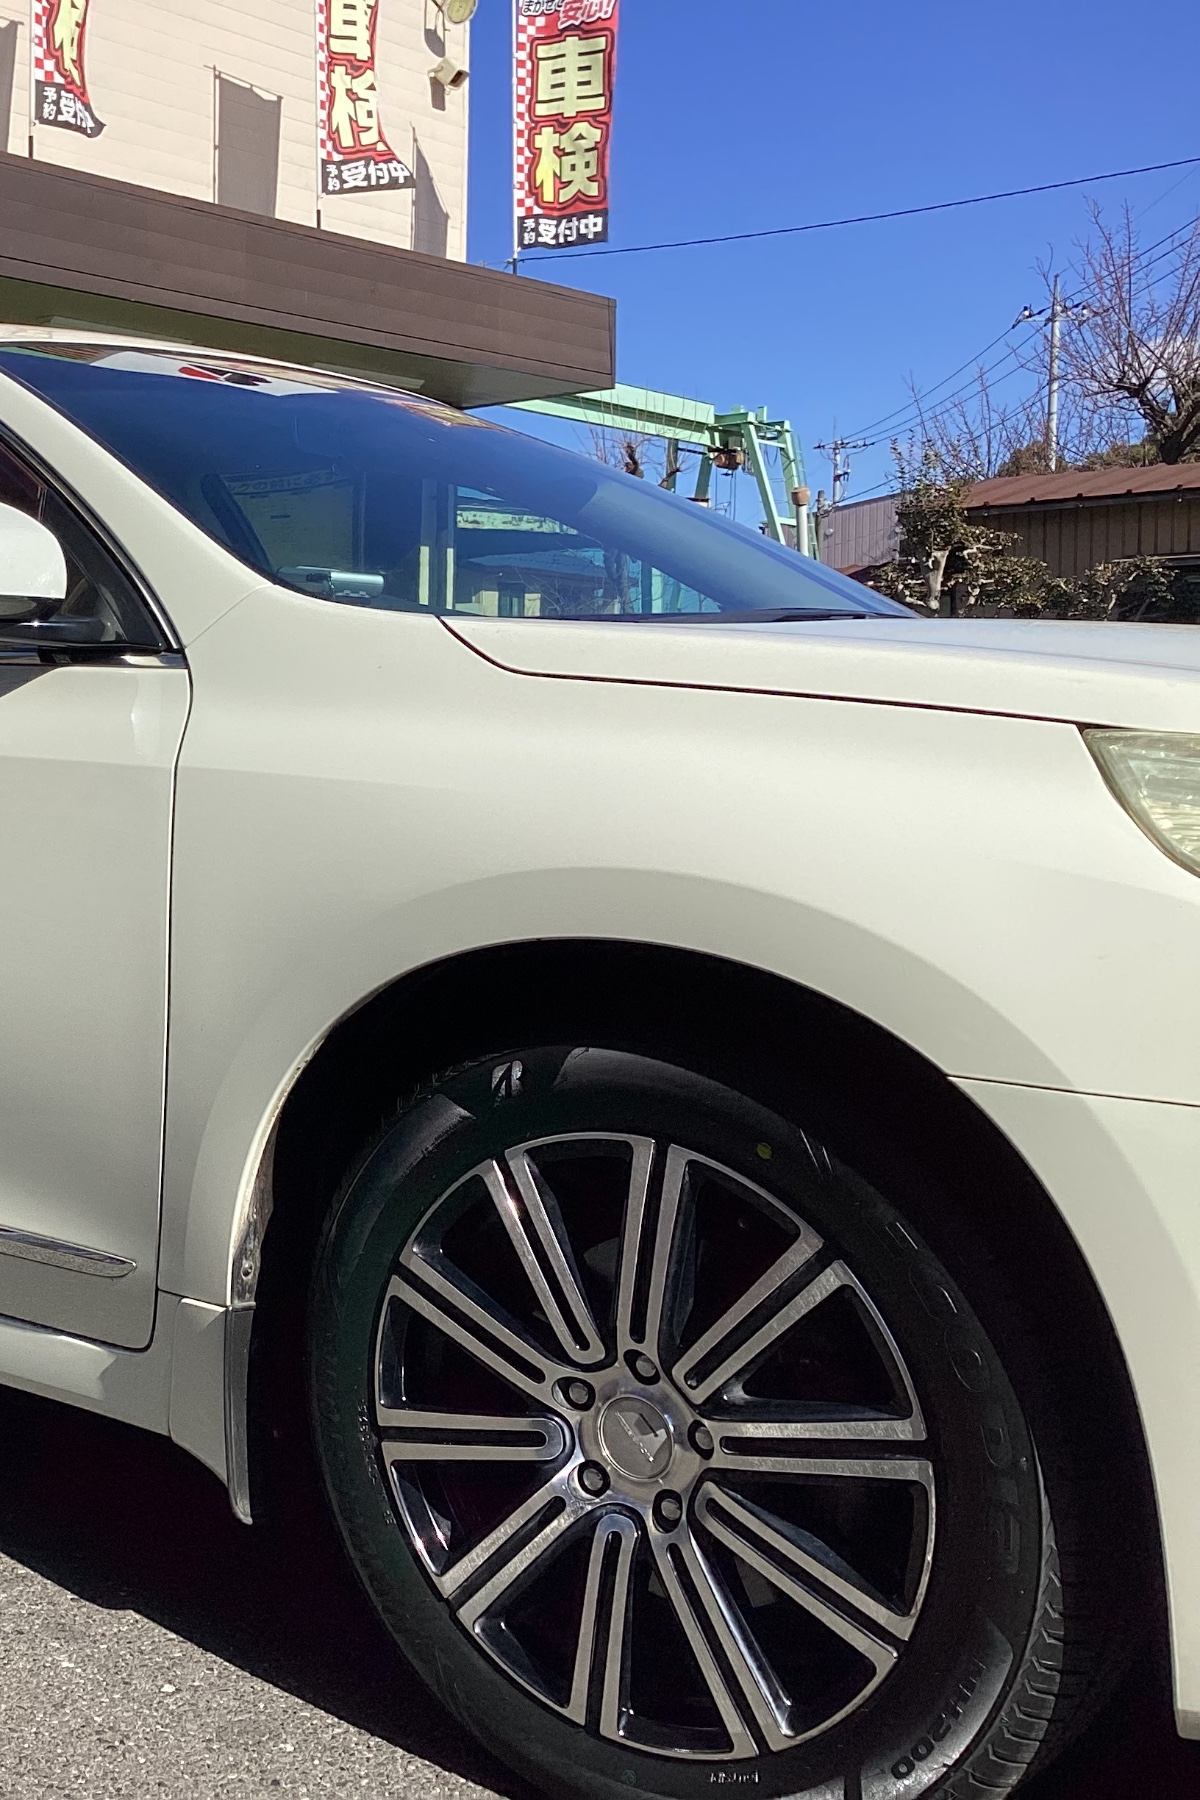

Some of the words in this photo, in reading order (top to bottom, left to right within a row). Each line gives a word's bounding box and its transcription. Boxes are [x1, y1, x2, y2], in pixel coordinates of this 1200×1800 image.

[43, 86, 57, 120] 予約
[534, 36, 607, 204] 車検
[326, 163, 341, 191] 予約
[341, 160, 411, 189] 受付中
[523, 218, 536, 245] 予約
[538, 214, 603, 245] 受付中
